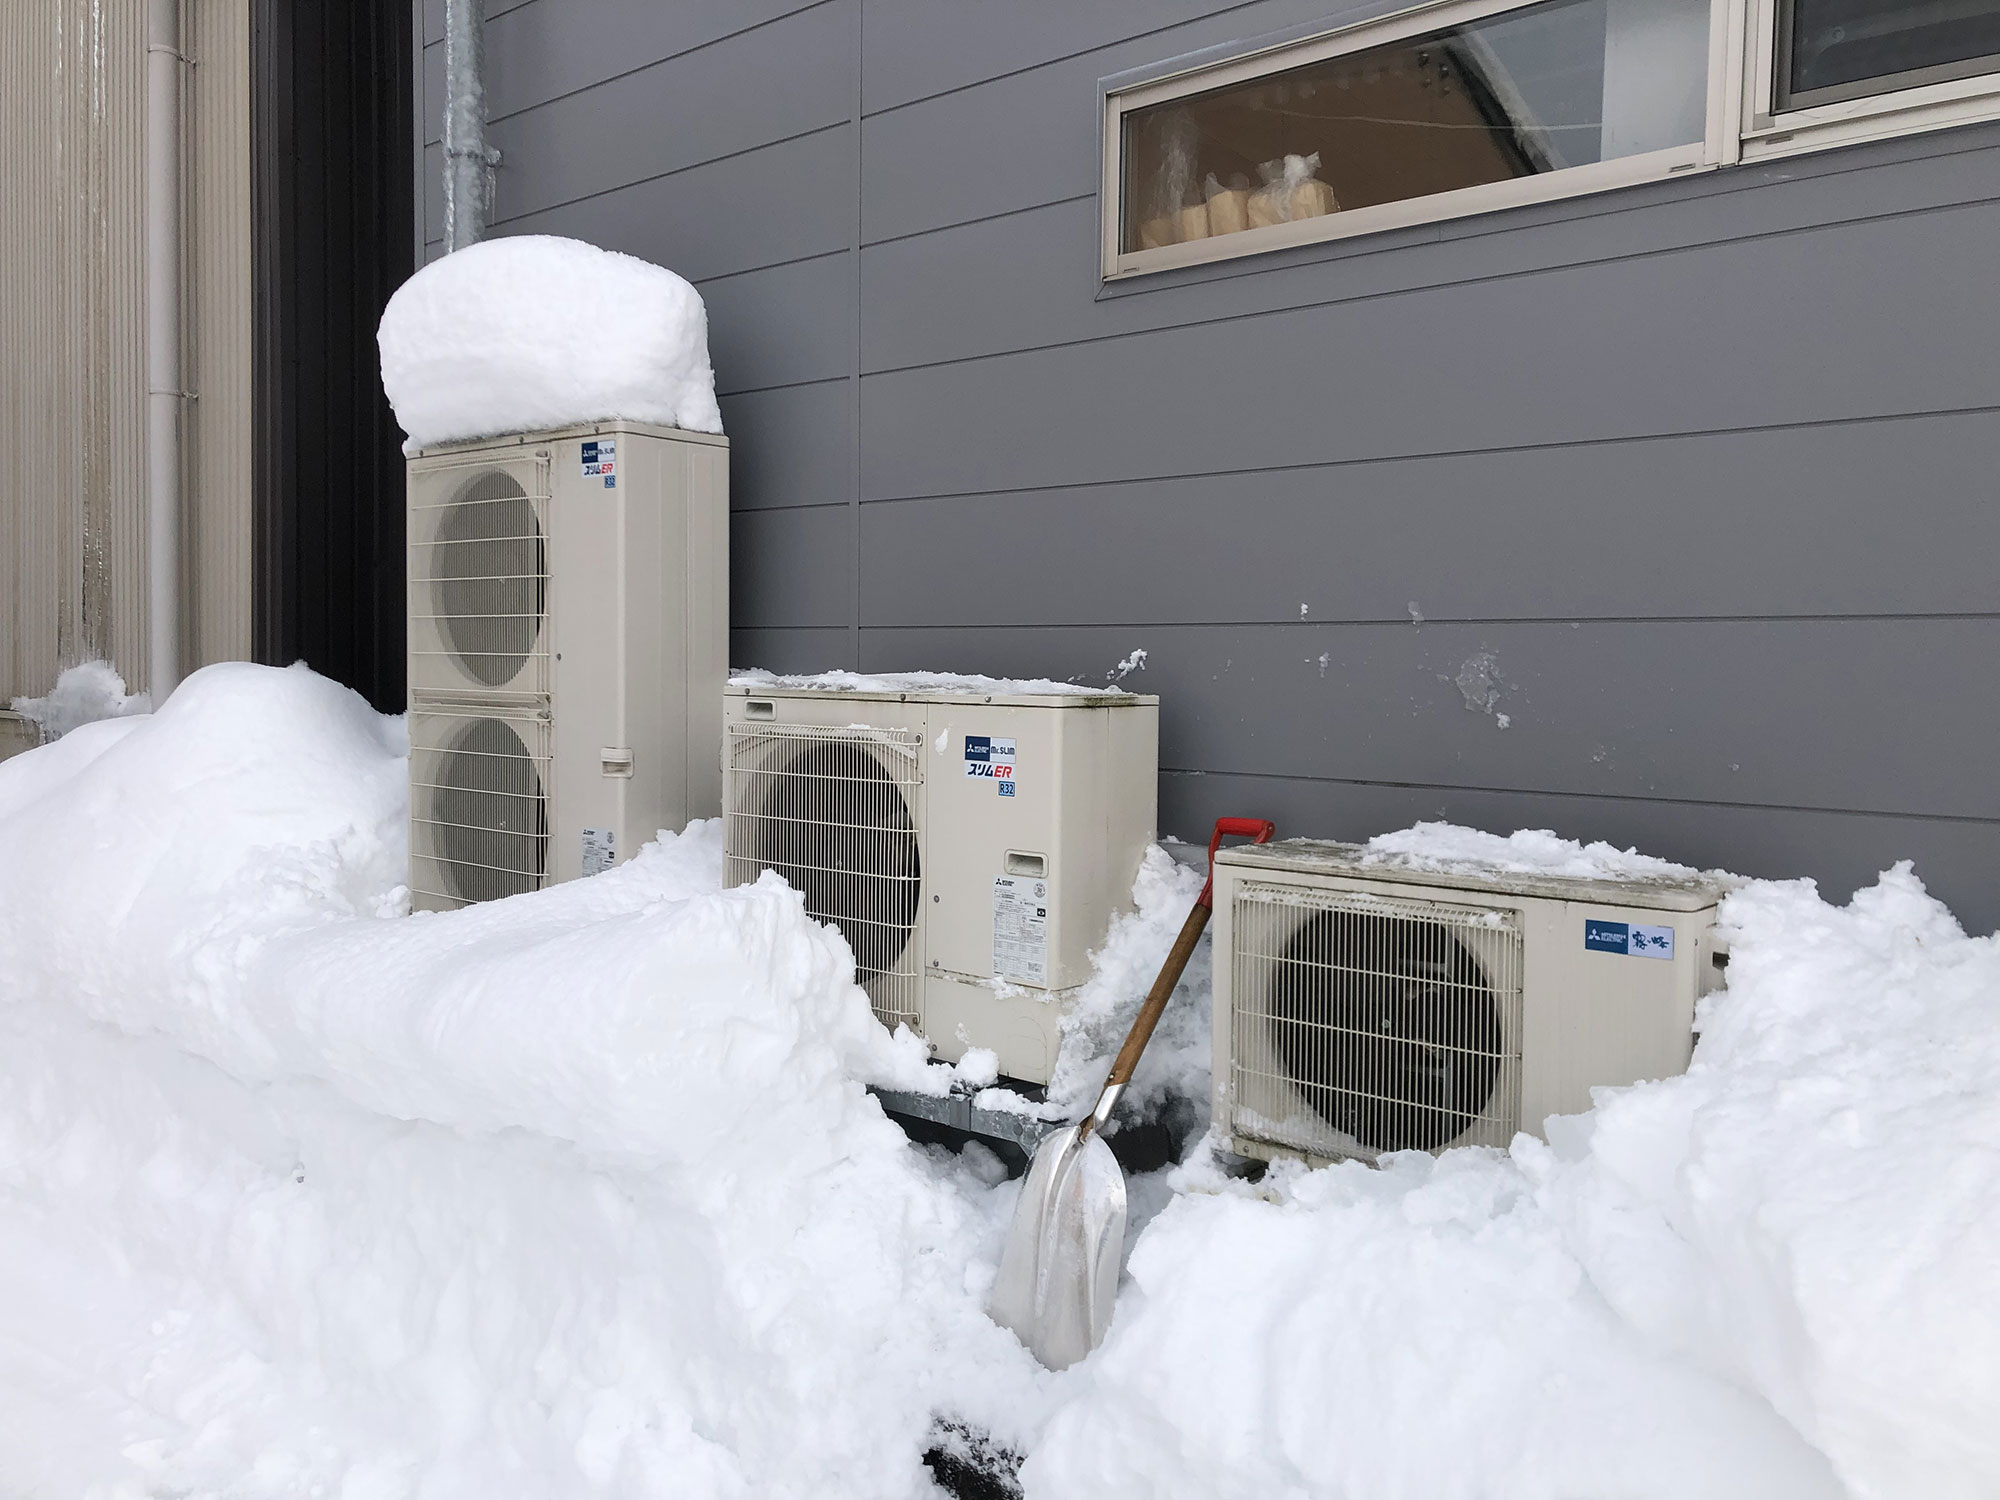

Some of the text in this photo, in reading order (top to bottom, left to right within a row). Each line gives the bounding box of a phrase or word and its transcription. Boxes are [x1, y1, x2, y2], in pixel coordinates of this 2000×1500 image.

[967, 763, 1013, 778] スリムER
[1000, 783, 1014, 795] R32
